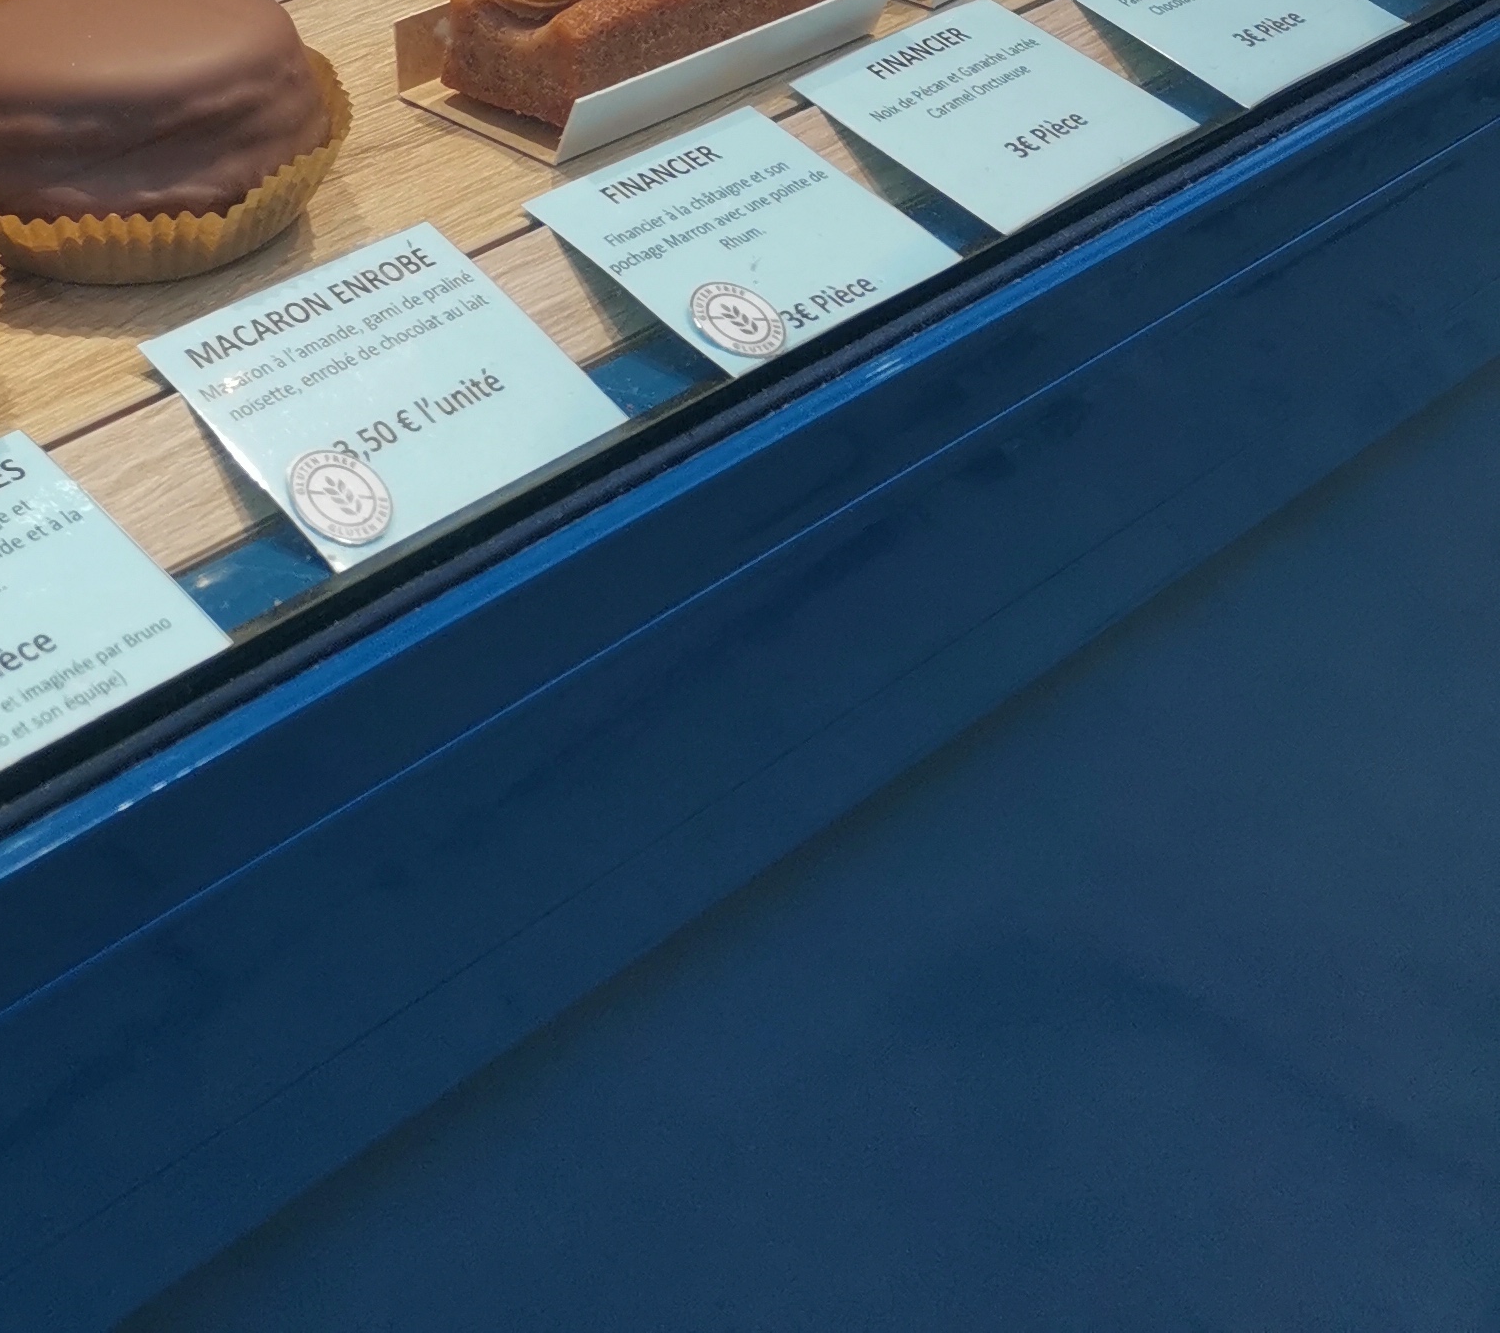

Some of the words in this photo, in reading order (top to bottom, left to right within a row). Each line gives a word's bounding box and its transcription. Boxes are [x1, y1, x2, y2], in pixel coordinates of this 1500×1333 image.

[866, 27, 970, 78] FINANCIER
[1232, 28, 1266, 47] 3€
[1253, 13, 1305, 37] Pièce
[868, 105, 901, 121] Noix
[898, 97, 917, 108] de
[910, 79, 949, 100] Pécan
[946, 72, 963, 83] et
[957, 52, 1007, 76] Ganache
[1000, 38, 1040, 56] Lactée
[926, 89, 976, 118] Caramel
[971, 65, 1030, 95] Onctueuse
[1004, 135, 1040, 158] 3€
[1029, 114, 1087, 143] Pièce
[599, 145, 722, 204] FINANCIER
[602, 214, 666, 247] Financier
[661, 208, 679, 221] à
[670, 204, 693, 217] la
[689, 178, 752, 210] châtaigne
[748, 170, 768, 183] et
[762, 161, 790, 177] son
[608, 243, 667, 277] pochage
[660, 221, 716, 249] Marron
[713, 206, 747, 227] avec
[742, 195, 772, 213] une
[767, 177, 812, 204] pointe
[807, 169, 829, 183] de
[717, 227, 766, 250] Rhum.
[184, 292, 332, 368] MACARON
[326, 240, 436, 304] ENROBÉ
[269, 354, 288, 369] à
[361, 301, 403, 331] garni
[400, 294, 424, 310] de
[421, 269, 475, 304] praliné
[775, 301, 820, 329] 3€
[808, 277, 878, 314] Pièce
[228, 383, 303, 421] noisette,
[300, 351, 359, 387] enrobé
[357, 344, 381, 361] de
[378, 314, 444, 350] chocolat
[441, 305, 464, 322] au
[457, 293, 490, 312] lait
[395, 408, 422, 433] €
[10, 498, 32, 516] et
[25, 524, 49, 542] et
[45, 516, 64, 532] à
[58, 509, 84, 524] la
[94, 642, 122, 666] par
[121, 617, 172, 648] Bruno
[30, 705, 63, 729] son
